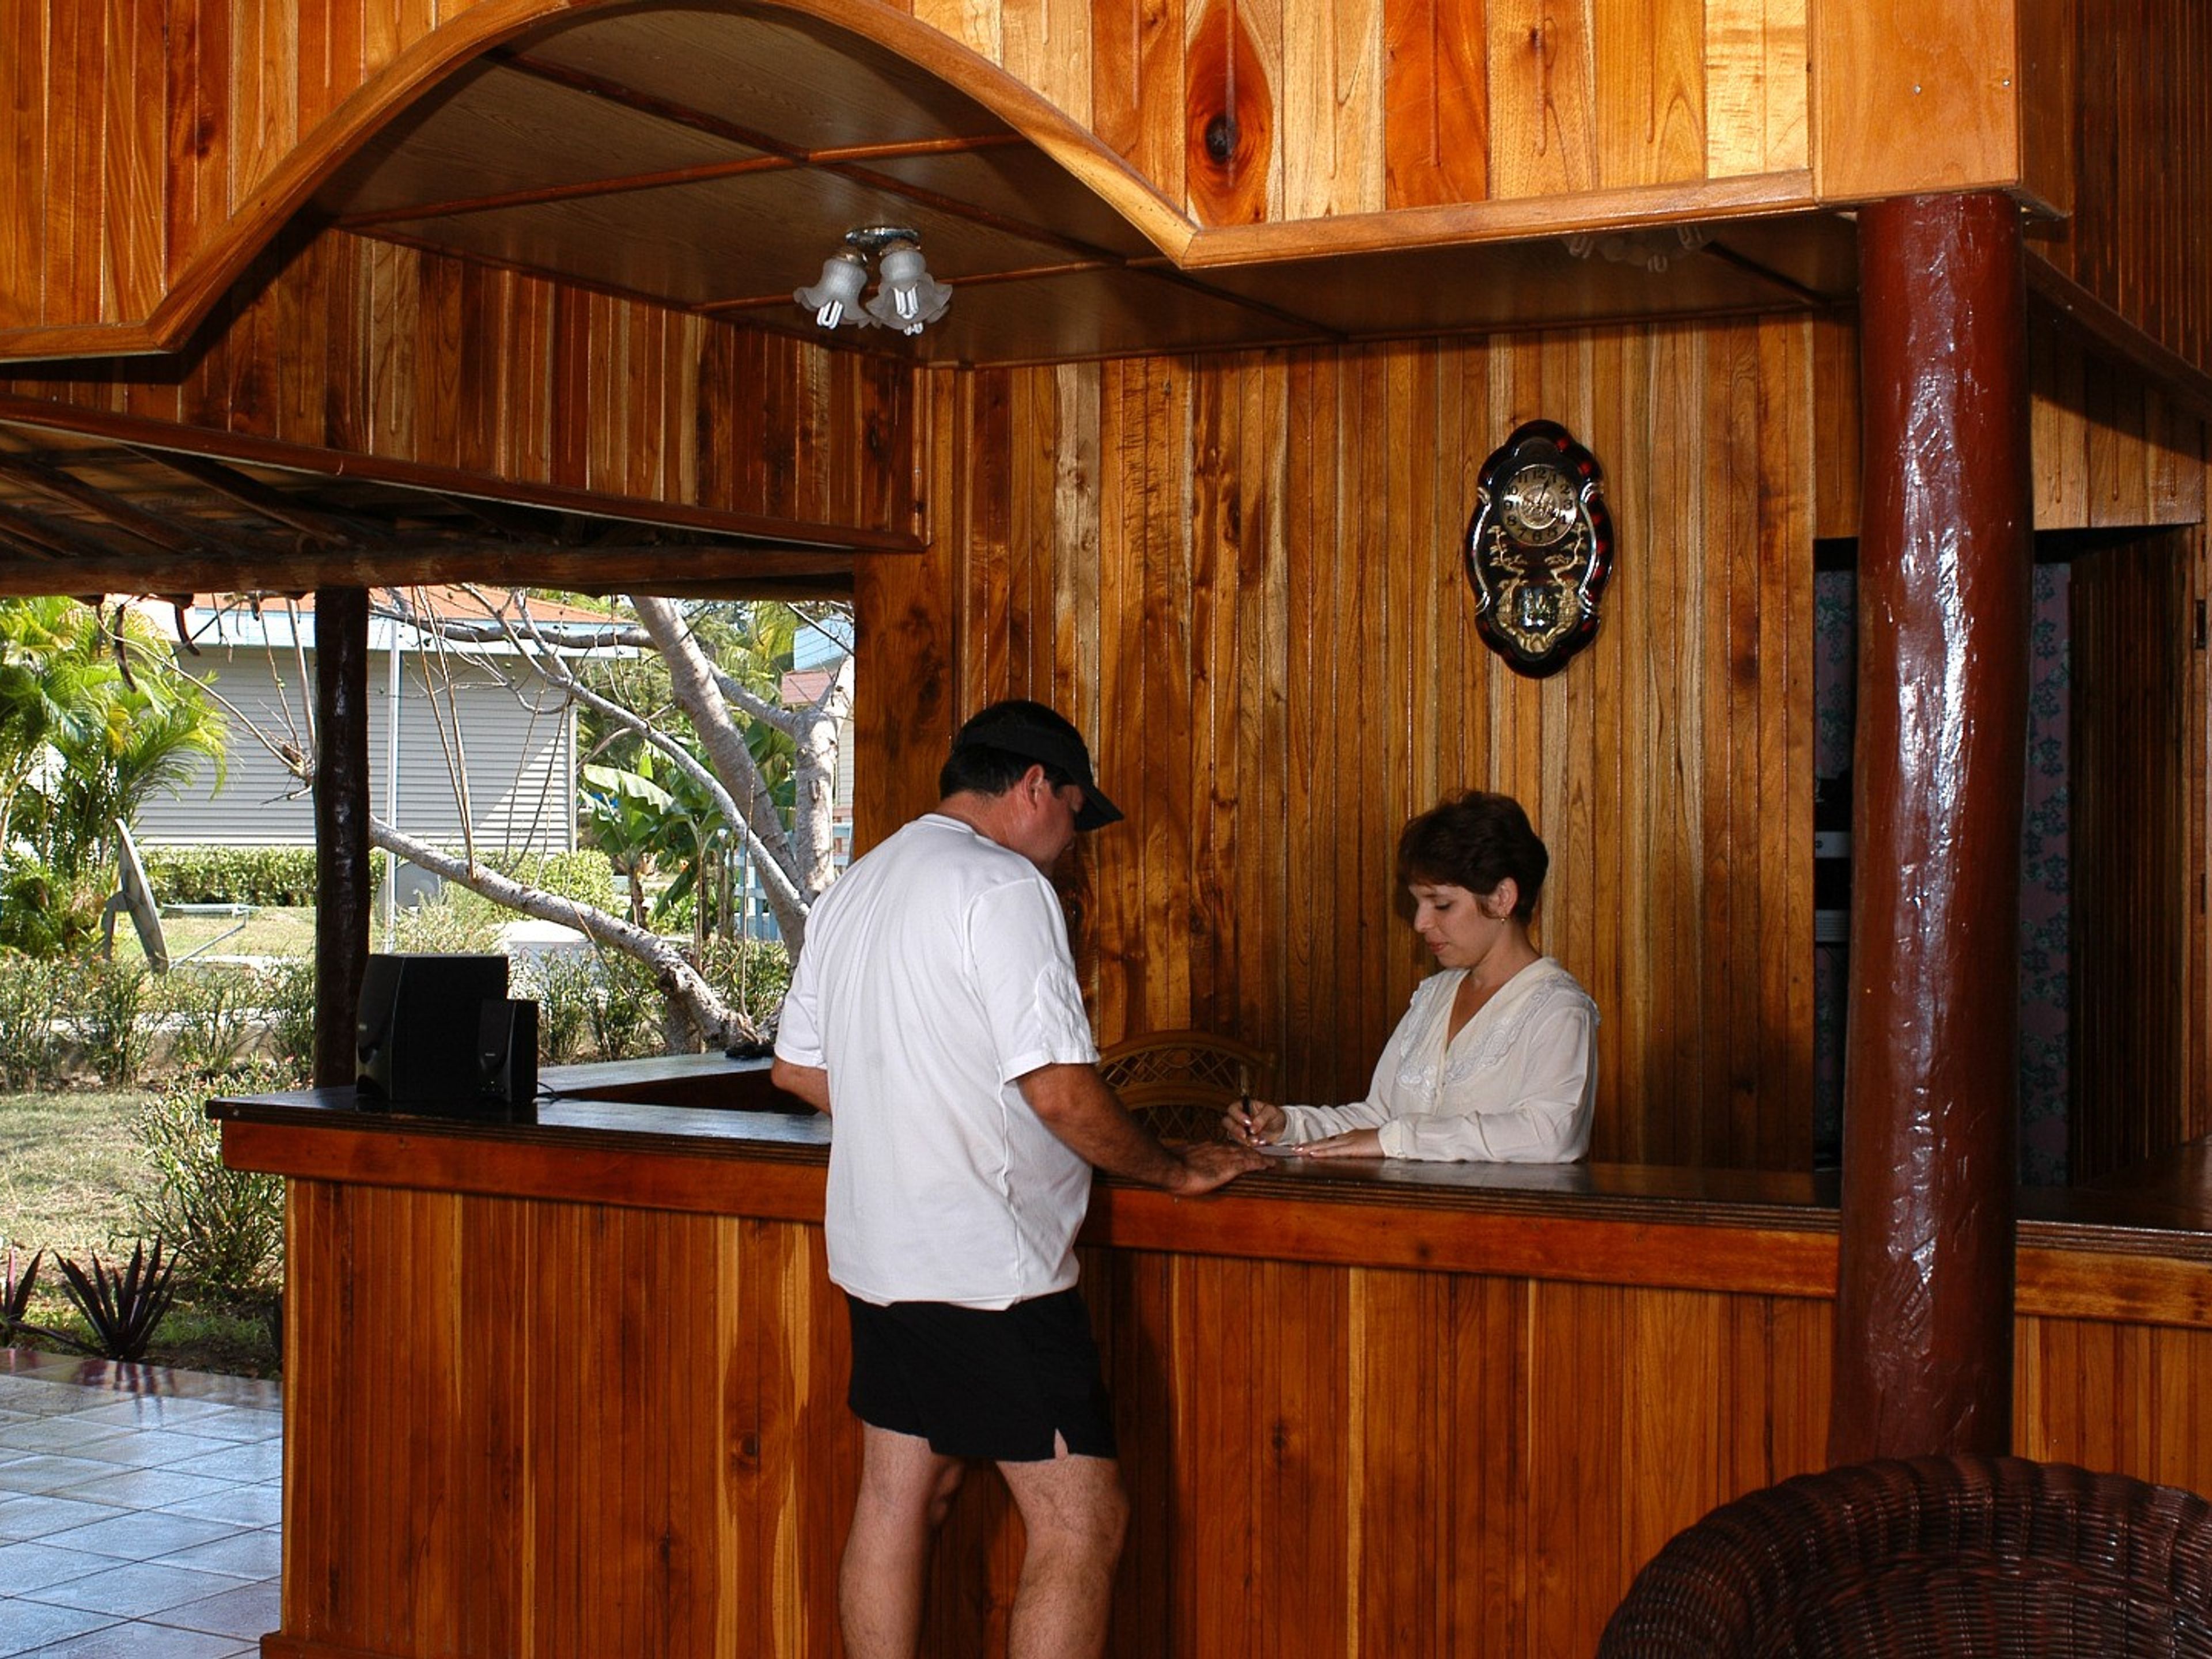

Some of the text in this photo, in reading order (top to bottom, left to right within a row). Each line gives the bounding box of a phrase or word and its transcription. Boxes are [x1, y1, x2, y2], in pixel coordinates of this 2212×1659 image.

[1518, 474, 1528, 483] 11
[1533, 469, 1546, 479] 12
[1552, 474, 1556, 483] 1
[1560, 484, 1570, 494] 2
[1503, 500, 1513, 510] 9
[1563, 499, 1573, 510] 3
[1507, 515, 1516, 525] 8
[1517, 528, 1527, 538] 7
[1533, 531, 1542, 541] 6
[1548, 527, 1558, 537] 5
